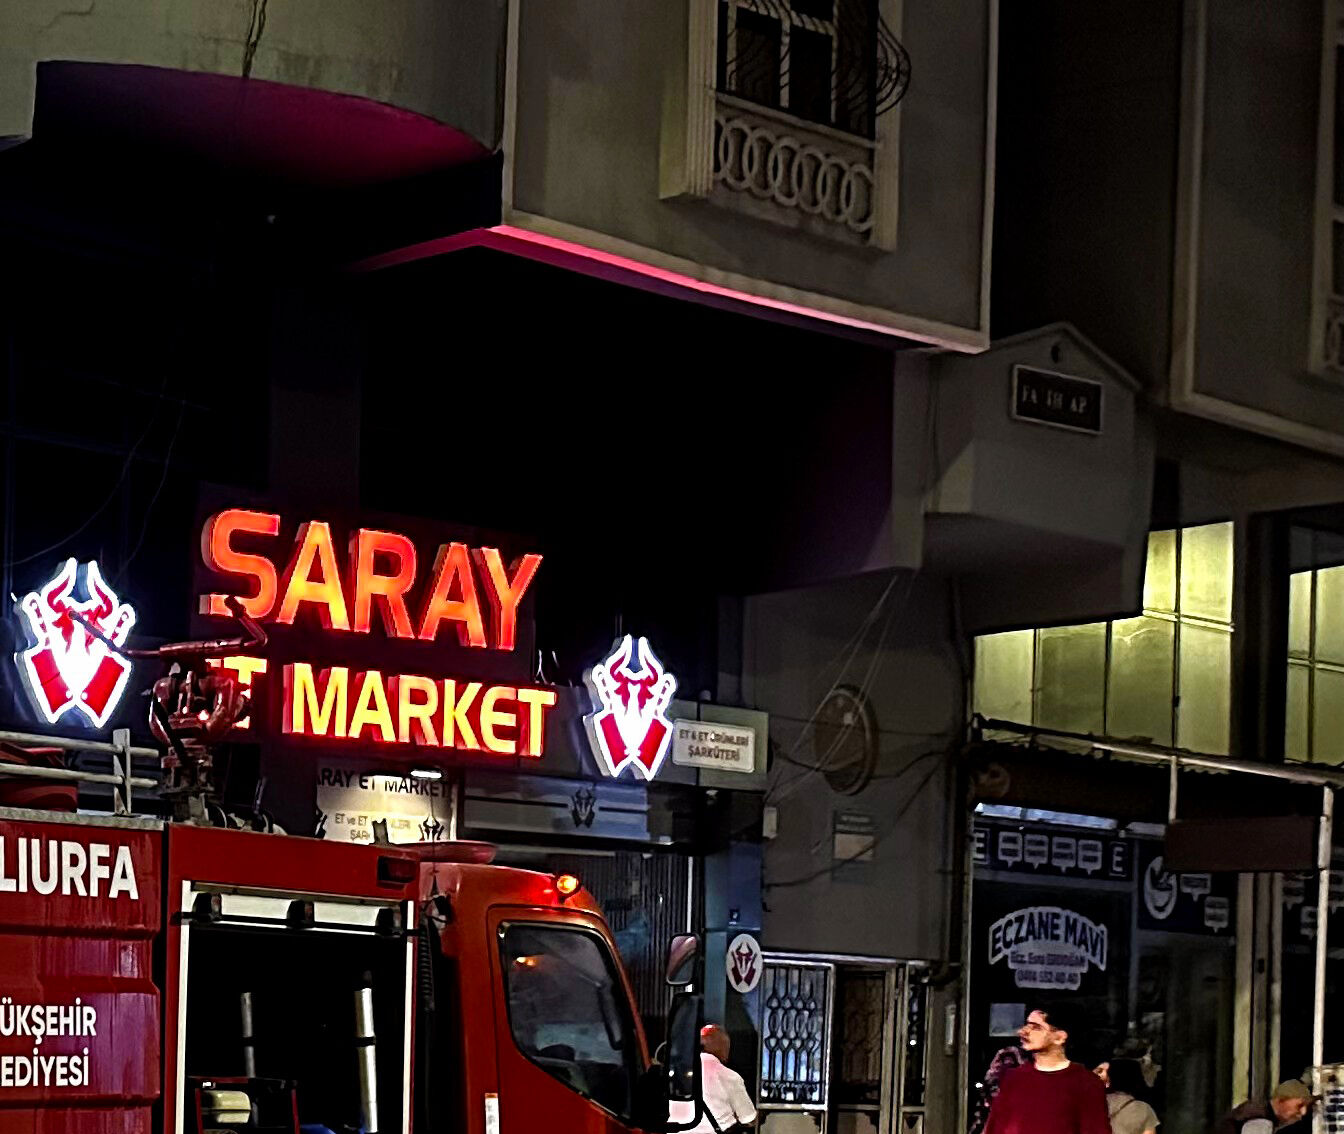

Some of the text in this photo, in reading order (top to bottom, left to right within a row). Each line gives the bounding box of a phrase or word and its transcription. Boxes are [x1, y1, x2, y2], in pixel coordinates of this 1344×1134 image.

[201, 508, 544, 651] SARAY
[284, 659, 556, 758] MARKET
[991, 911, 1105, 964] ECZANE MAVİ
